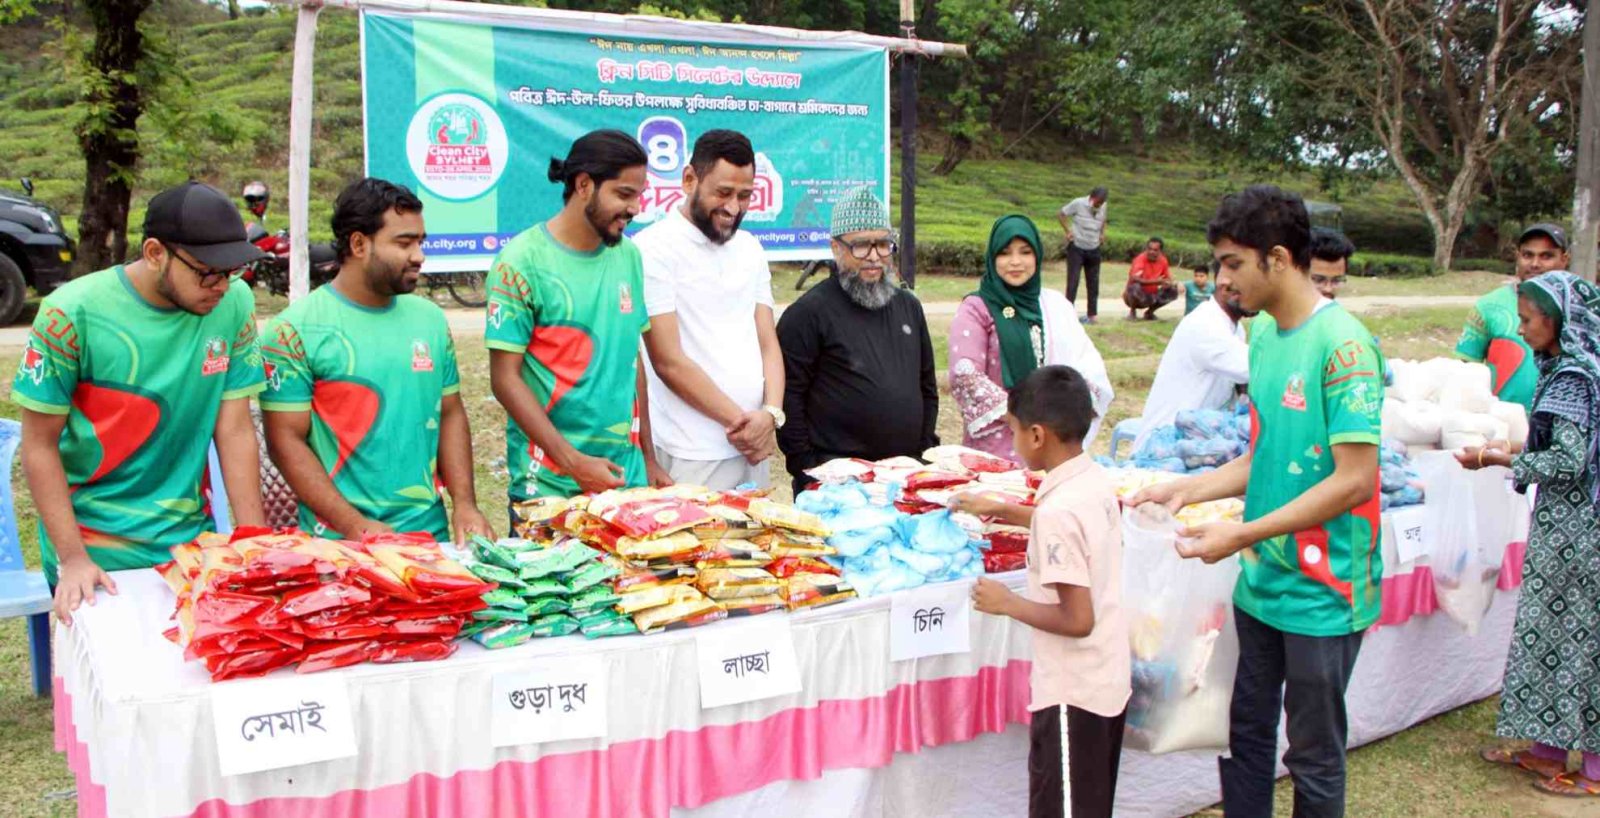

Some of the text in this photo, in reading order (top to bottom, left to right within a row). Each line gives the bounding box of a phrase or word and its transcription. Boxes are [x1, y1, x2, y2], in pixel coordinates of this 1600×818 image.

[597, 58, 801, 89] ক্লিন সিটি সিলেটের উদ্যোগে
[510, 87, 543, 105] পবিত্র
[546, 89, 633, 108] ঈদ-উল-ফিতর
[635, 92, 683, 109] উপলক্ষে
[686, 94, 747, 113] সুবিধাবঞ্চিত
[798, 98, 845, 116] শ্রমিকদের
[847, 104, 868, 116] জন্য
[429, 146, 487, 157] Clean City
[436, 156, 481, 165] SYLHET
[912, 606, 946, 634] চিনি
[721, 648, 770, 678] লাচ্ছা
[508, 682, 588, 714] গুড়া দুধ
[241, 699, 327, 741] সেমাই
